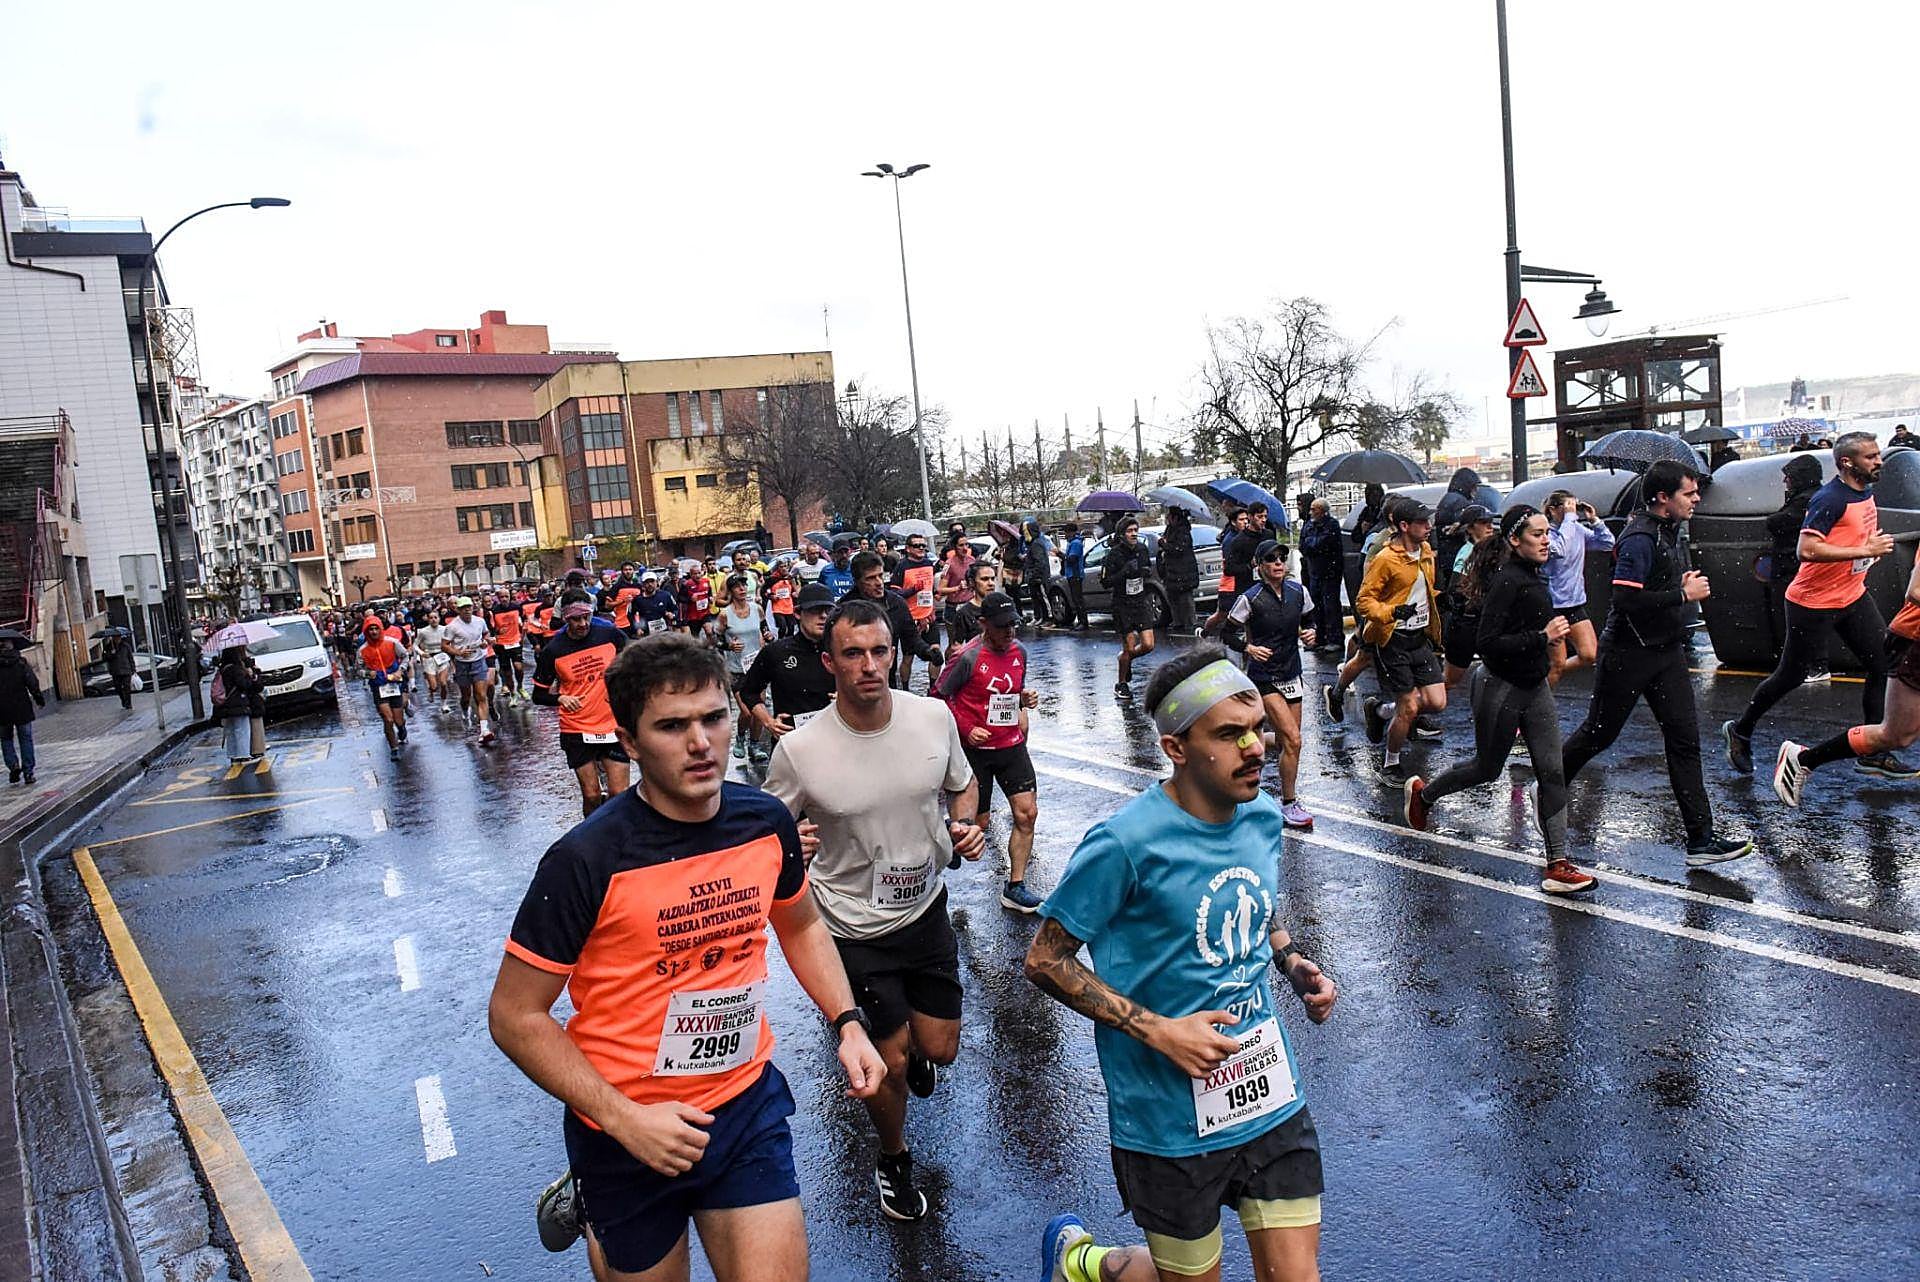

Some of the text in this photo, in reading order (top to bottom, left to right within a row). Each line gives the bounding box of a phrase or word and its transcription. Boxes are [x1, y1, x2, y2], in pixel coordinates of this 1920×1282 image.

[689, 877, 732, 899] XXXVII
[656, 895, 715, 923] NAZIOARTEKO
[657, 901, 761, 938] CARRERA INTERNACIONAL
[692, 999, 706, 1008] EL
[707, 992, 749, 1007] CORREO
[721, 1013, 755, 1031] BILBAO
[723, 1006, 756, 1021] SANTURCE
[674, 1015, 722, 1034] XXXVII
[689, 1031, 741, 1060] 2999
[1238, 1034, 1262, 1052] RREO
[677, 1059, 726, 1070] kutxabank
[1243, 1045, 1276, 1066] SANTURCE
[1244, 1053, 1278, 1077] BILBAO
[1204, 1061, 1244, 1091] XXXVII
[1225, 1074, 1270, 1110] 1939
[1218, 1103, 1263, 1123] kutxabank
